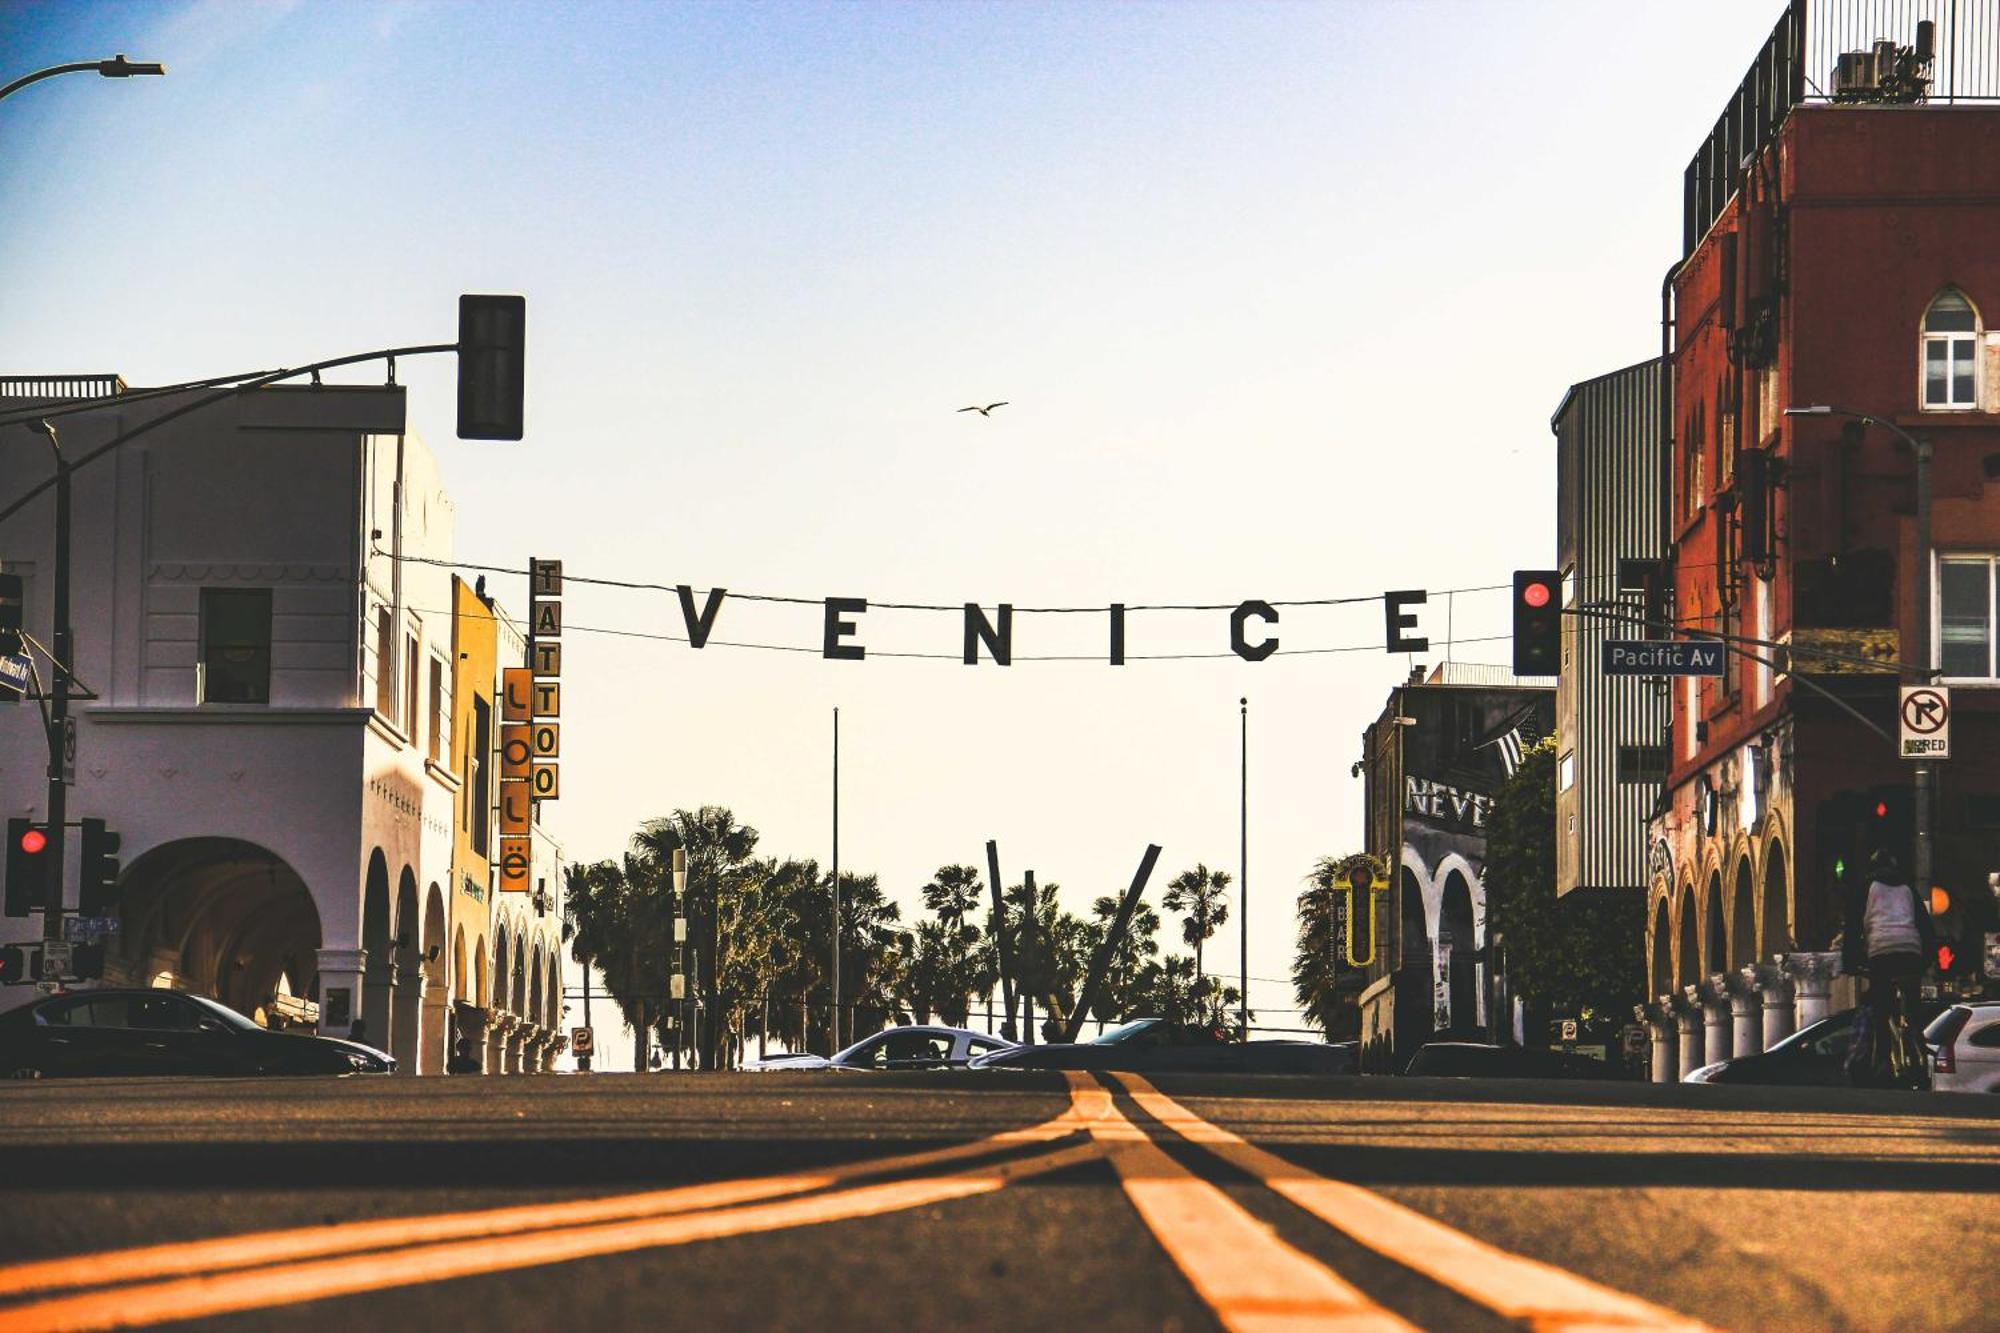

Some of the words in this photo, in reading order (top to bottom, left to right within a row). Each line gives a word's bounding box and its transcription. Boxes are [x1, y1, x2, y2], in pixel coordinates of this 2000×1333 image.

[677, 585, 1428, 666] VENICE
[1612, 648, 1684, 666] Pacific
[1690, 649, 1715, 666] Av
[536, 563, 558, 794] TATTOO
